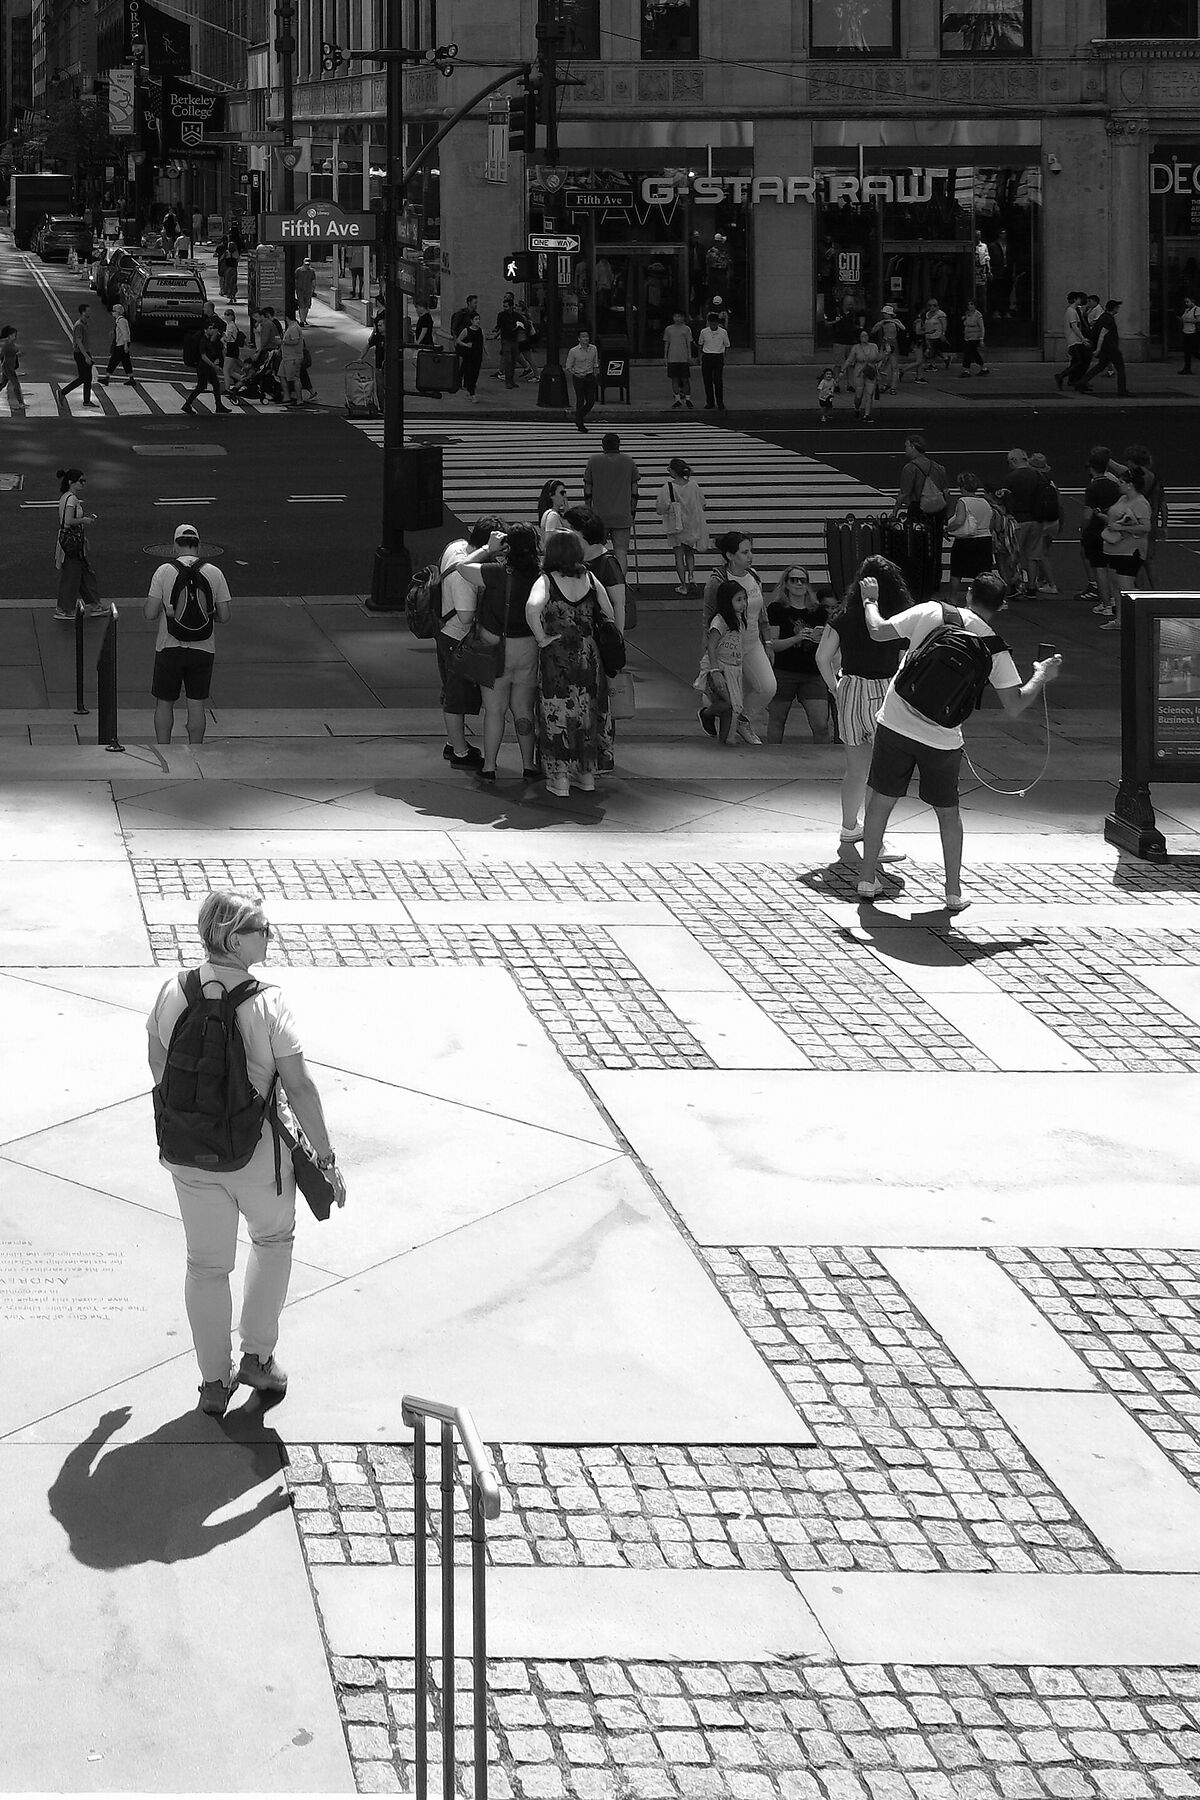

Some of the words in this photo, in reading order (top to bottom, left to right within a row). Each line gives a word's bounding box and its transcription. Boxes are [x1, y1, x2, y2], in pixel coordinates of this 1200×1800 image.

[170, 93, 216, 108] Berkeley
[171, 105, 213, 120] College
[641, 176, 816, 204] G-STAR
[828, 176, 932, 204] RAW
[576, 195, 601, 205] Fifth
[603, 195, 622, 205] Ave
[281, 220, 320, 237] Fifth
[326, 220, 361, 237] Ave
[1158, 705, 1193, 714] Science,
[1158, 715, 1195, 723] Business
